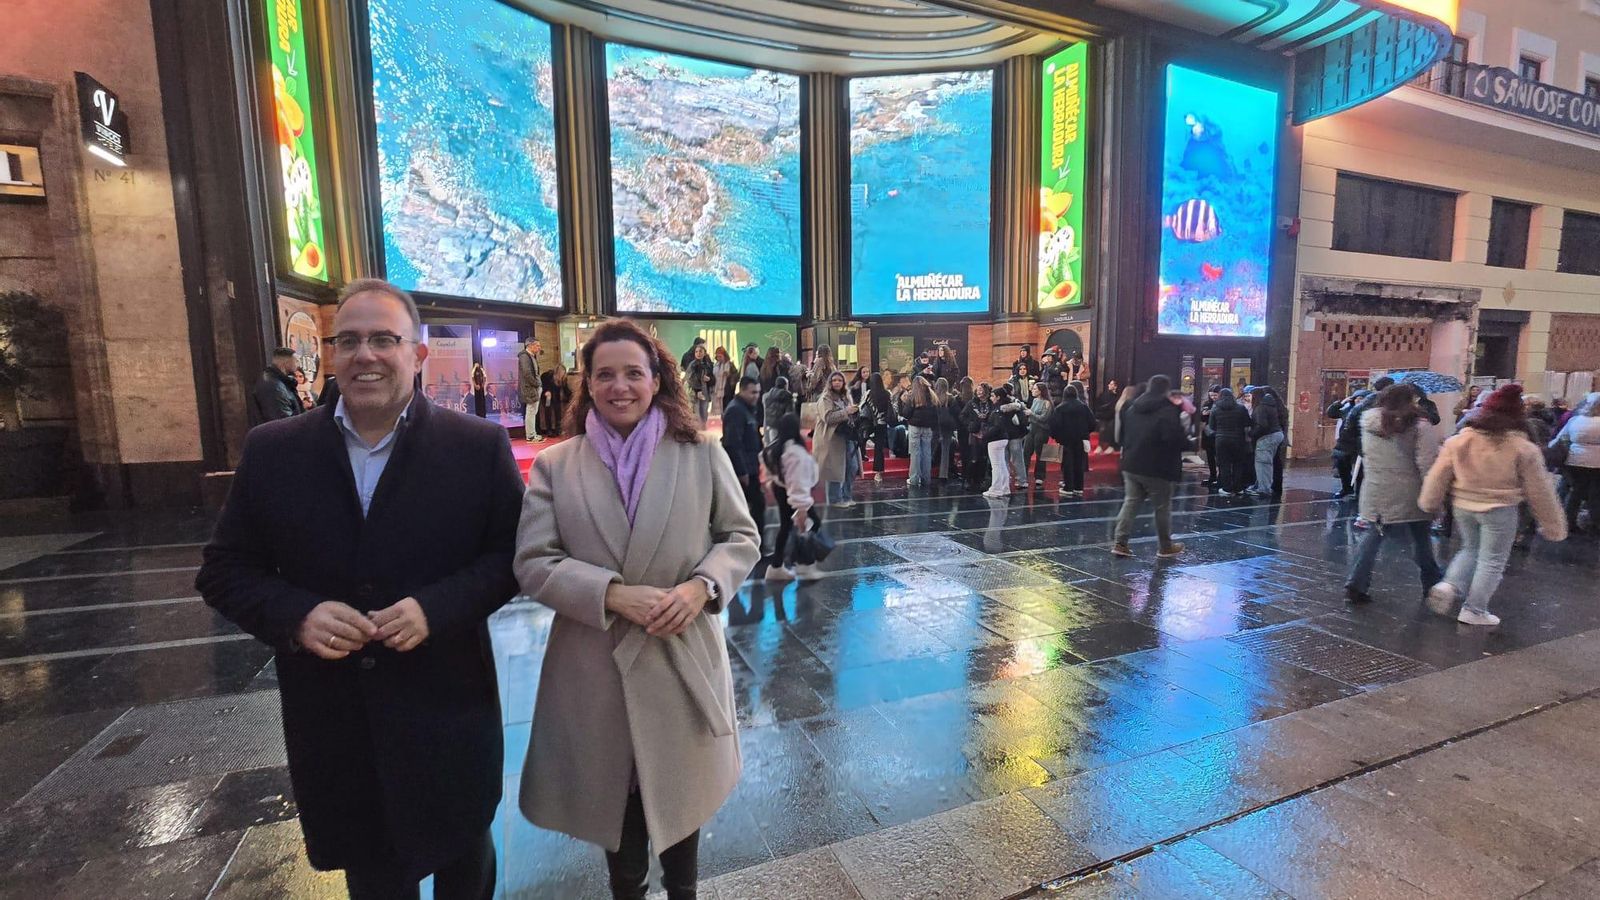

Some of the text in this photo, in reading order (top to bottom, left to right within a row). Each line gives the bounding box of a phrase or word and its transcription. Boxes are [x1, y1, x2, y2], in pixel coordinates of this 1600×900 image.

[1054, 66, 1066, 88] LA
[93, 89, 115, 126] V
[119, 170, 135, 185] 41
[896, 272, 963, 289] ALMUÑÉCAR
[896, 286, 981, 302] LA HERRADURA
[1189, 311, 1239, 325] LA HERRADURA
